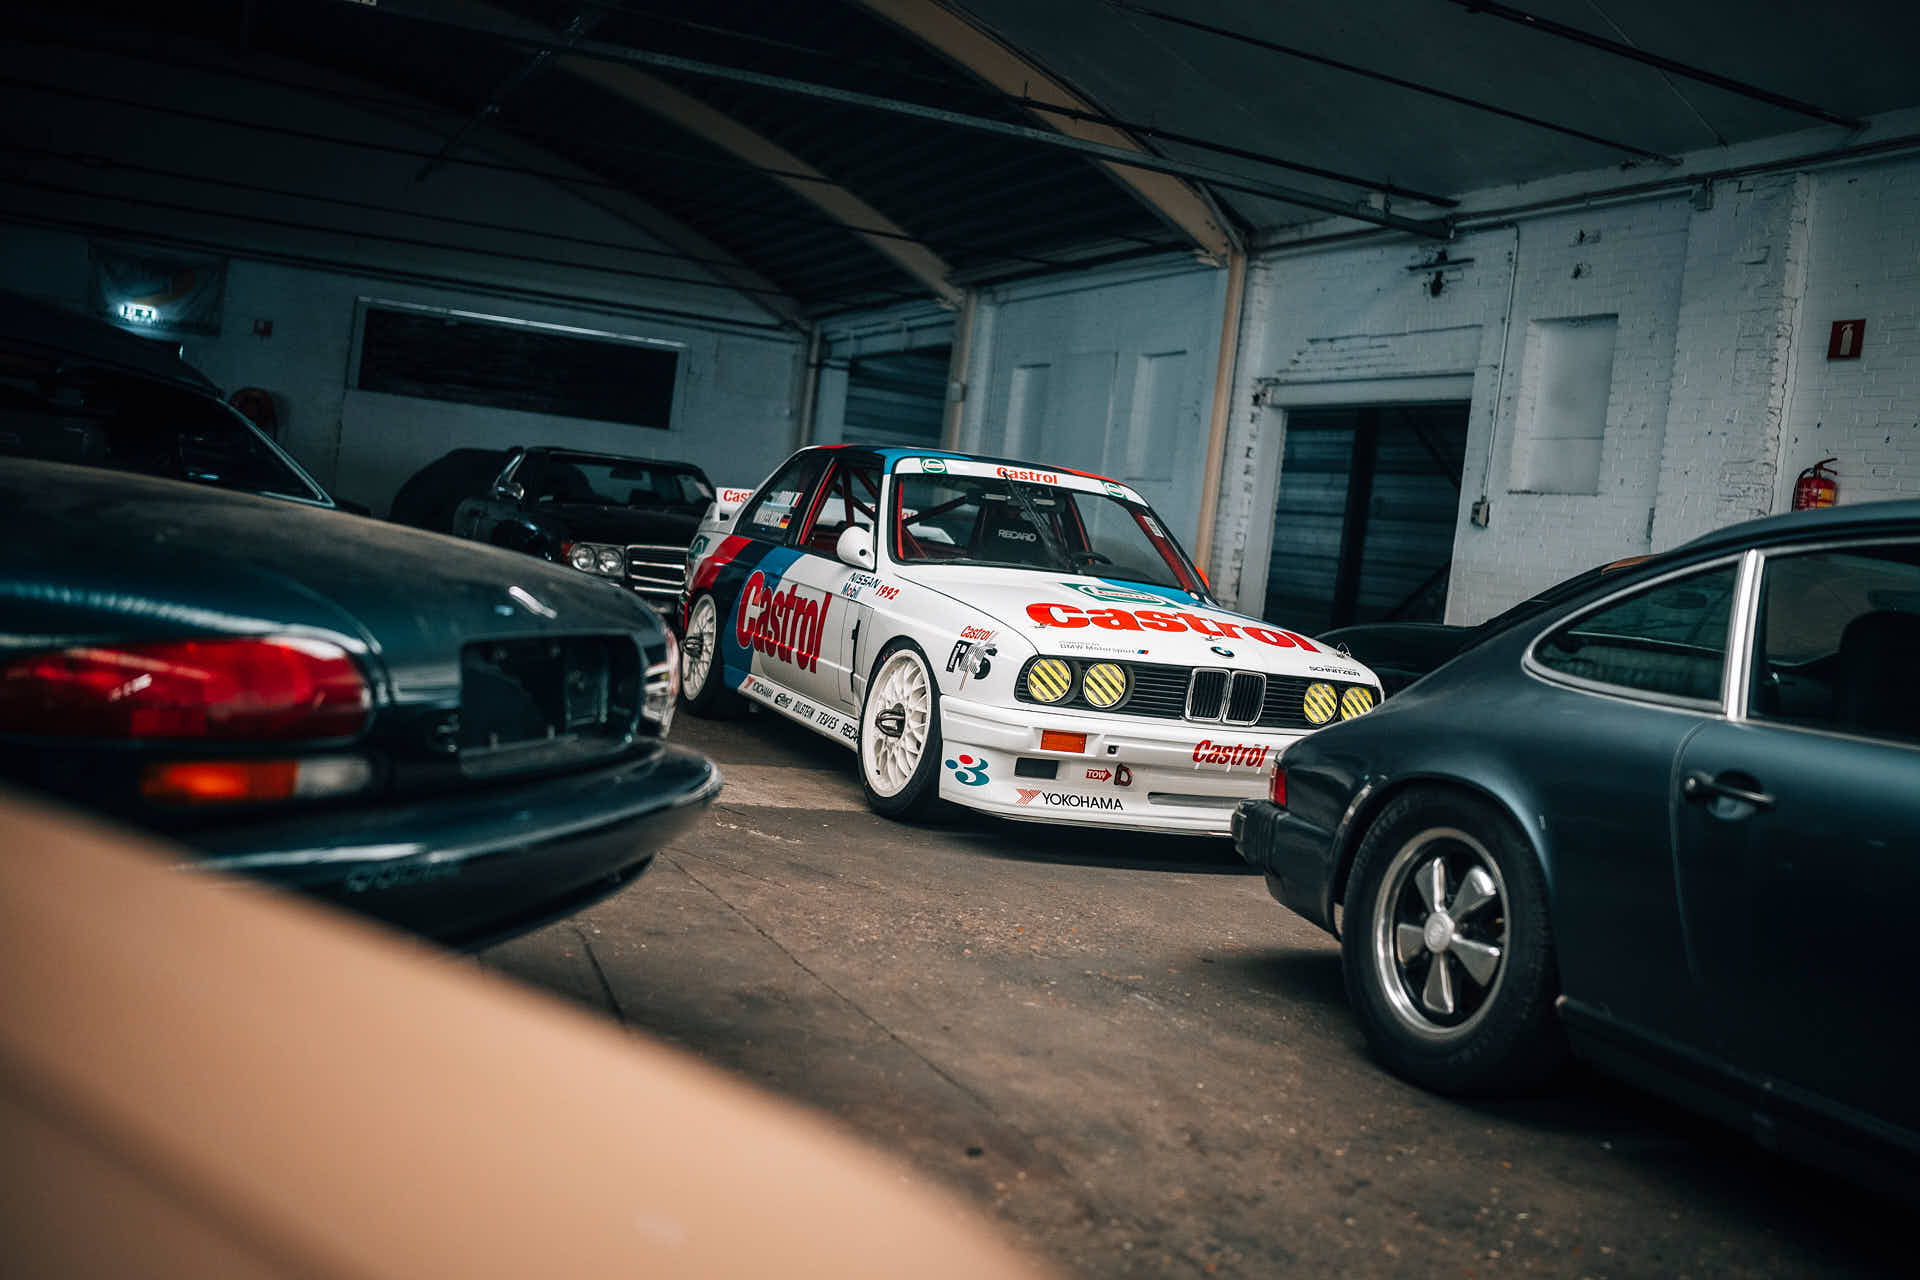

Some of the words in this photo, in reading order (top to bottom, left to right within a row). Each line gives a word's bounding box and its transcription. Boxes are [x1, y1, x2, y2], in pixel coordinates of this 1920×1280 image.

[996, 466, 1059, 485] Castrol
[723, 489, 753, 504] Cas
[998, 529, 1038, 542] RECARO
[848, 571, 882, 589] NISSAN
[875, 584, 901, 601] 1992
[736, 570, 833, 674] Castrol
[1026, 601, 1321, 654] Castrol
[960, 625, 996, 641] Castrol
[1309, 665, 1361, 677] SCHNITZER
[815, 711, 840, 730] TEVES
[1192, 739, 1271, 768] Castrol
[1086, 769, 1108, 781] TOW
[1041, 791, 1124, 811] YOKOHAMA
